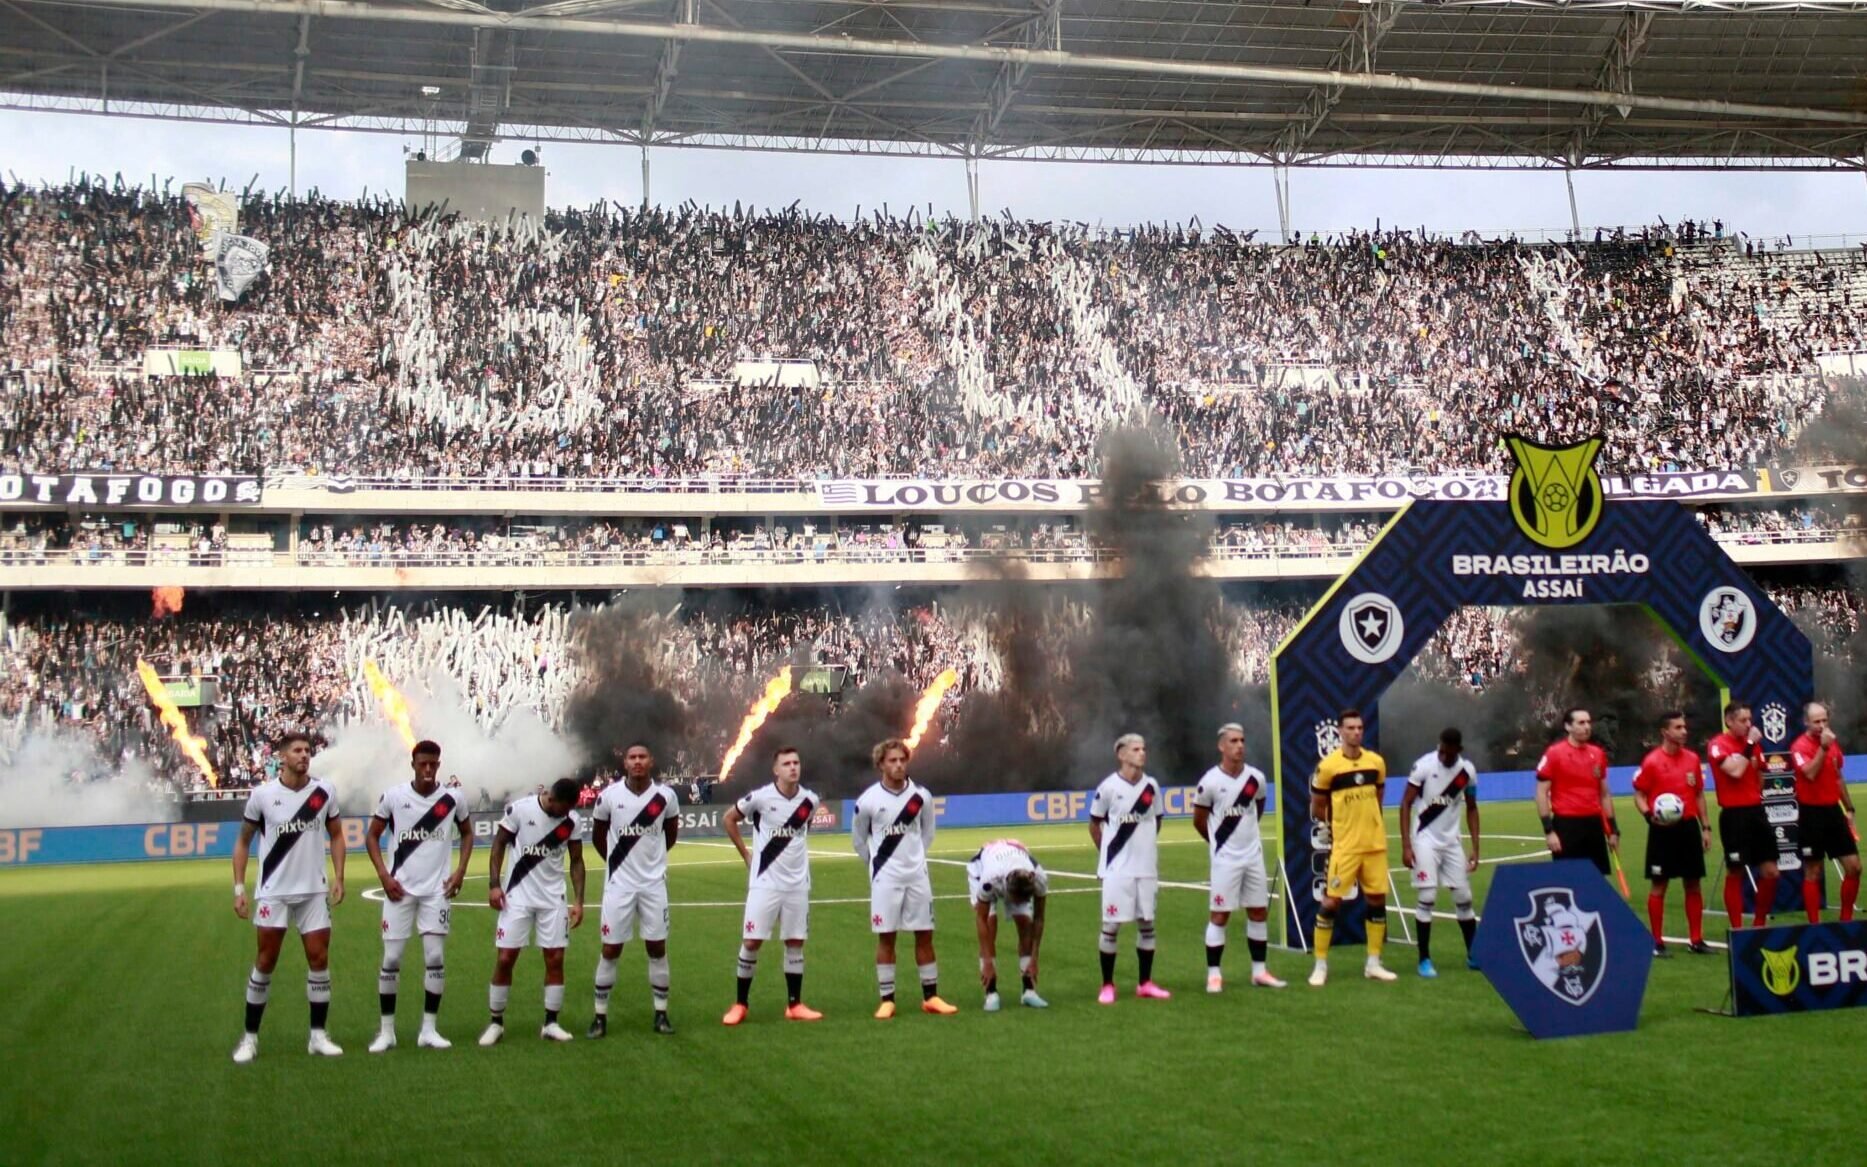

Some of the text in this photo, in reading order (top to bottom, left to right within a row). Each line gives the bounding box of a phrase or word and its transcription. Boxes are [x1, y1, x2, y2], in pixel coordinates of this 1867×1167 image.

[862, 481, 1060, 505] LOUCOS
[1452, 549, 1649, 575] BRASILEIRÃO
[1522, 578, 1584, 598] ASSAÍ
[1027, 786, 1196, 820] CBF CB
[275, 819, 320, 838] pixbet
[678, 811, 717, 828] SSAÍ
[144, 823, 219, 856] CBF
[399, 827, 447, 843] pixbet
[1808, 949, 1867, 986] BR
